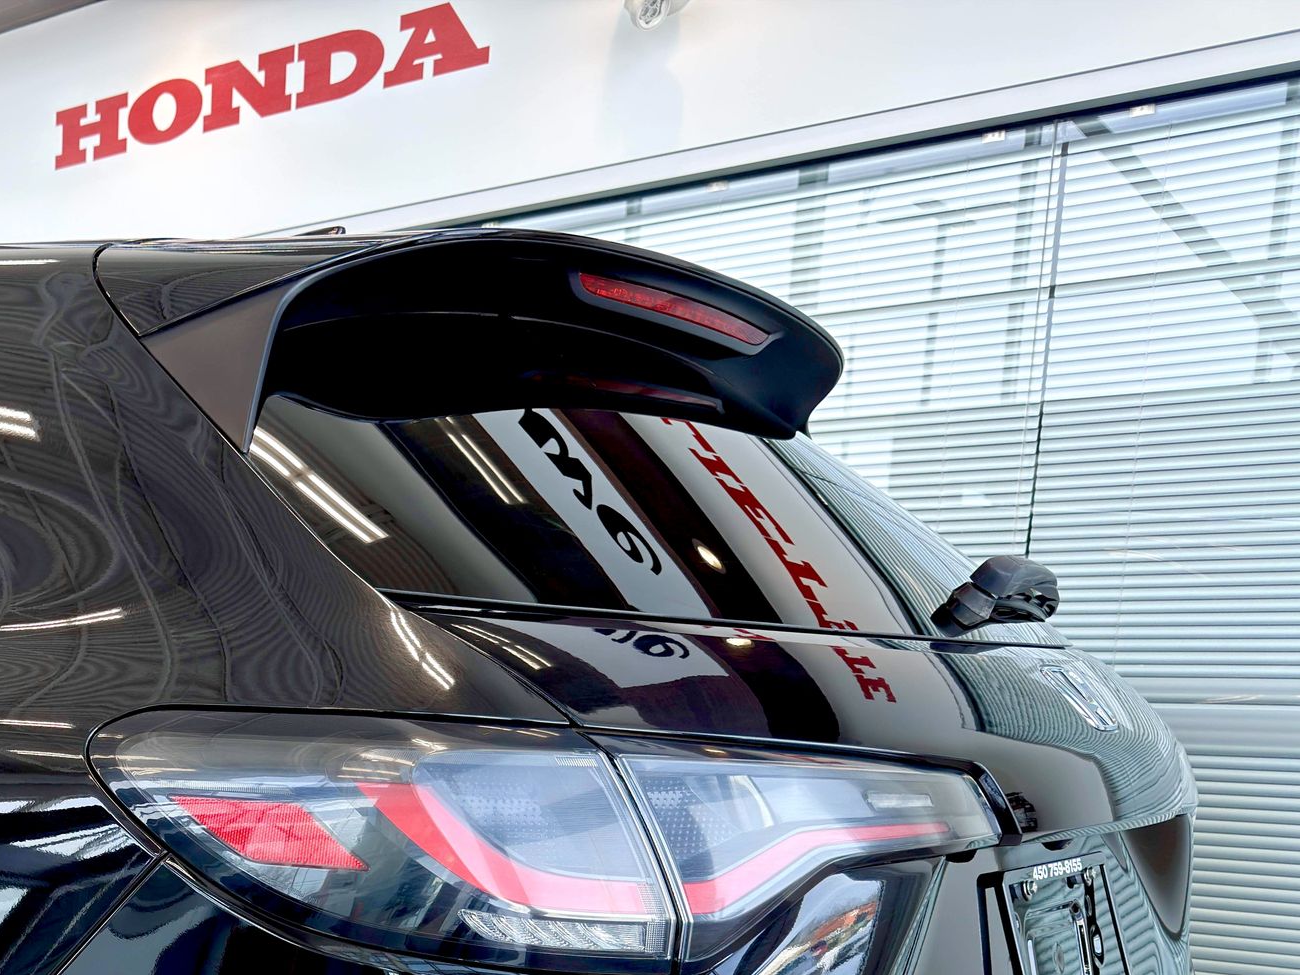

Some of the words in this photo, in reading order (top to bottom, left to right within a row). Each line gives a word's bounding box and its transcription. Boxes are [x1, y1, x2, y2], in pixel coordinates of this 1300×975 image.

[54, 1, 491, 171] HONDA
[1032, 864, 1048, 880] 450
[1047, 857, 1083, 878] 759-8155
